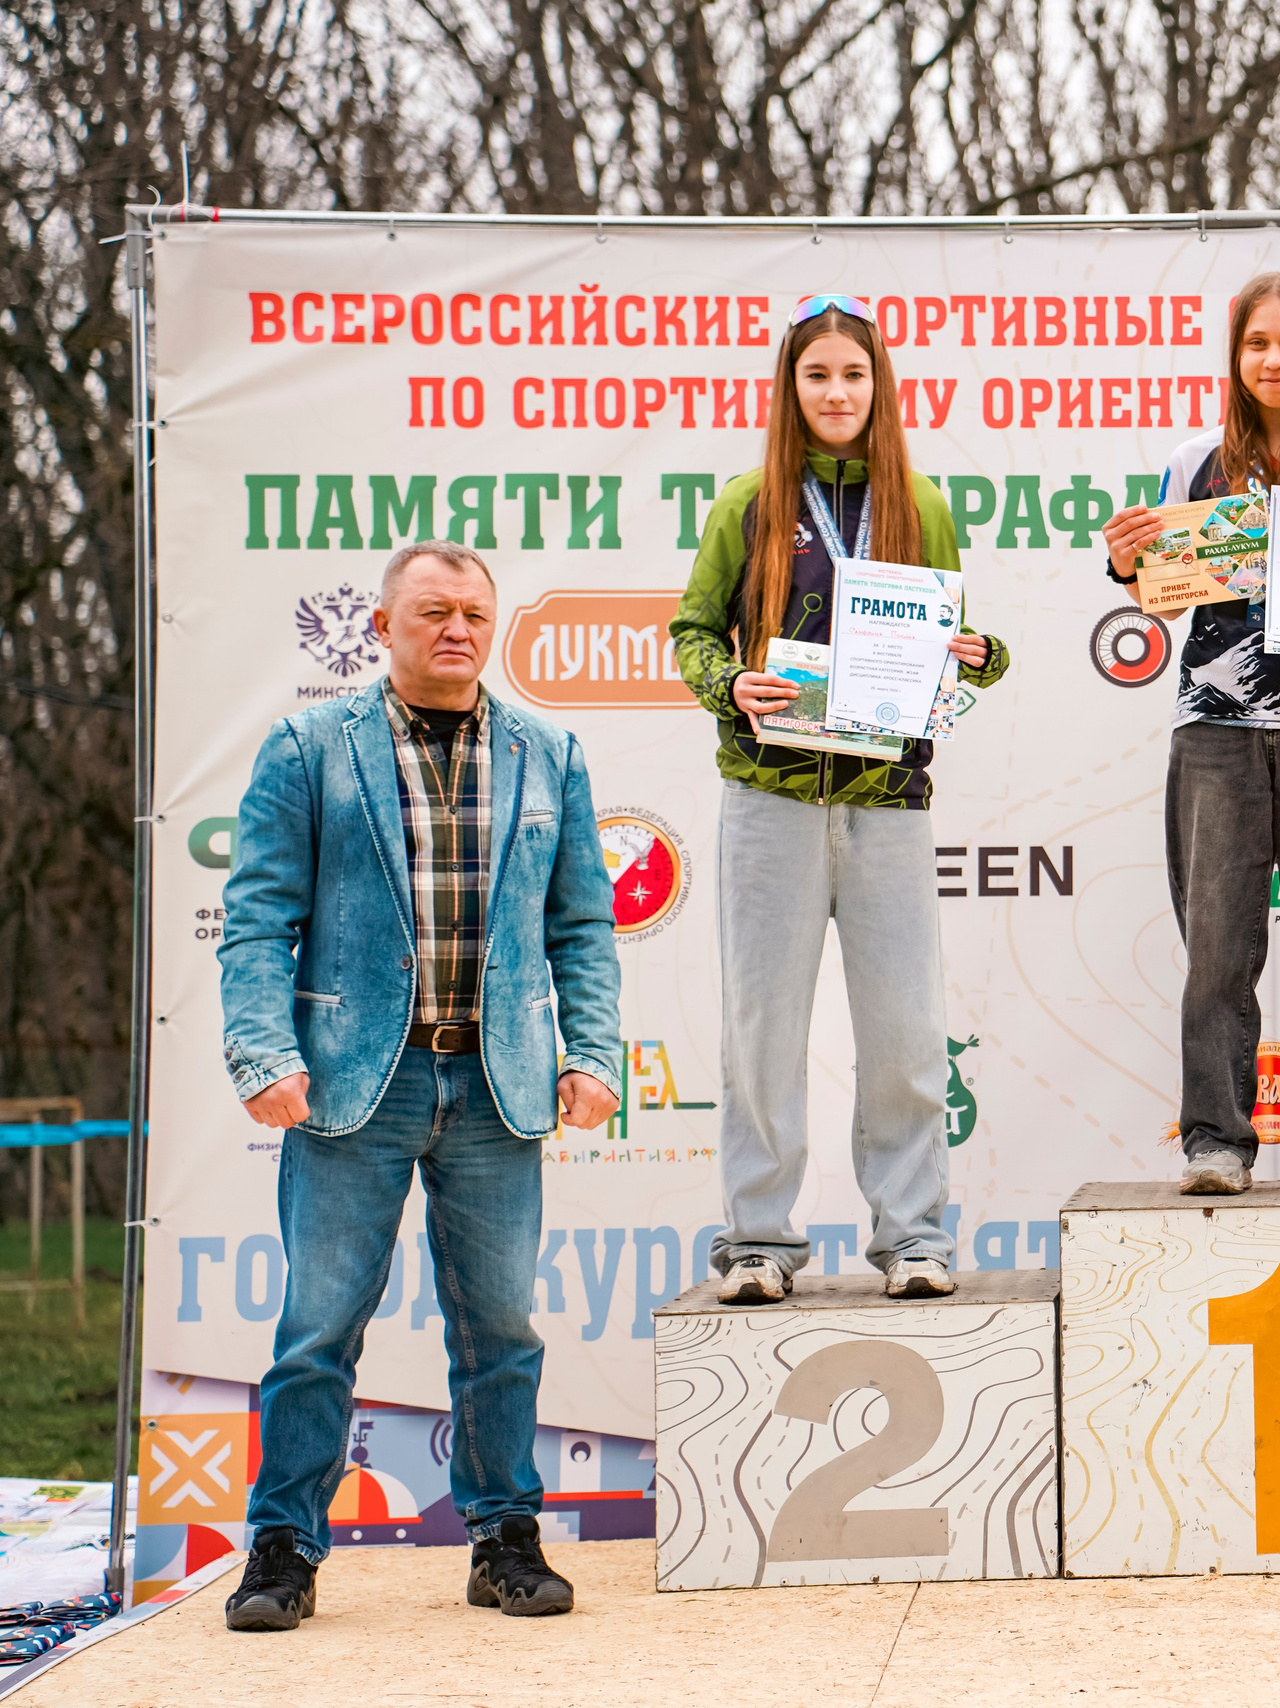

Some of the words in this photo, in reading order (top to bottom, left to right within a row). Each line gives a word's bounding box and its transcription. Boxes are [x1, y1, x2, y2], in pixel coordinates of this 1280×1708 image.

[248, 284, 769, 346] ВСЕРОССИЙСКИЕ
[798, 294, 1202, 347] ОРТИВНЫЕ
[408, 377, 484, 429] ПО
[244, 473, 622, 550] ПАМЯТИ
[1204, 541, 1260, 556] РАХАТ-ЛУКУМ
[1148, 597, 1158, 605] ИЗ
[1160, 590, 1209, 603] ПЯТИГОРСКА
[1161, 582, 1191, 593] ПРИВЕТ
[851, 596, 927, 621] ГРАМОТА
[297, 686, 364, 699] МИНСП
[763, 715, 821, 733] ПЯТИГОРСК
[629, 806, 684, 847] ФЕДЕРАЦИЯ
[614, 925, 664, 945] ОРИЕНТИ
[766, 1339, 949, 1563] 2
